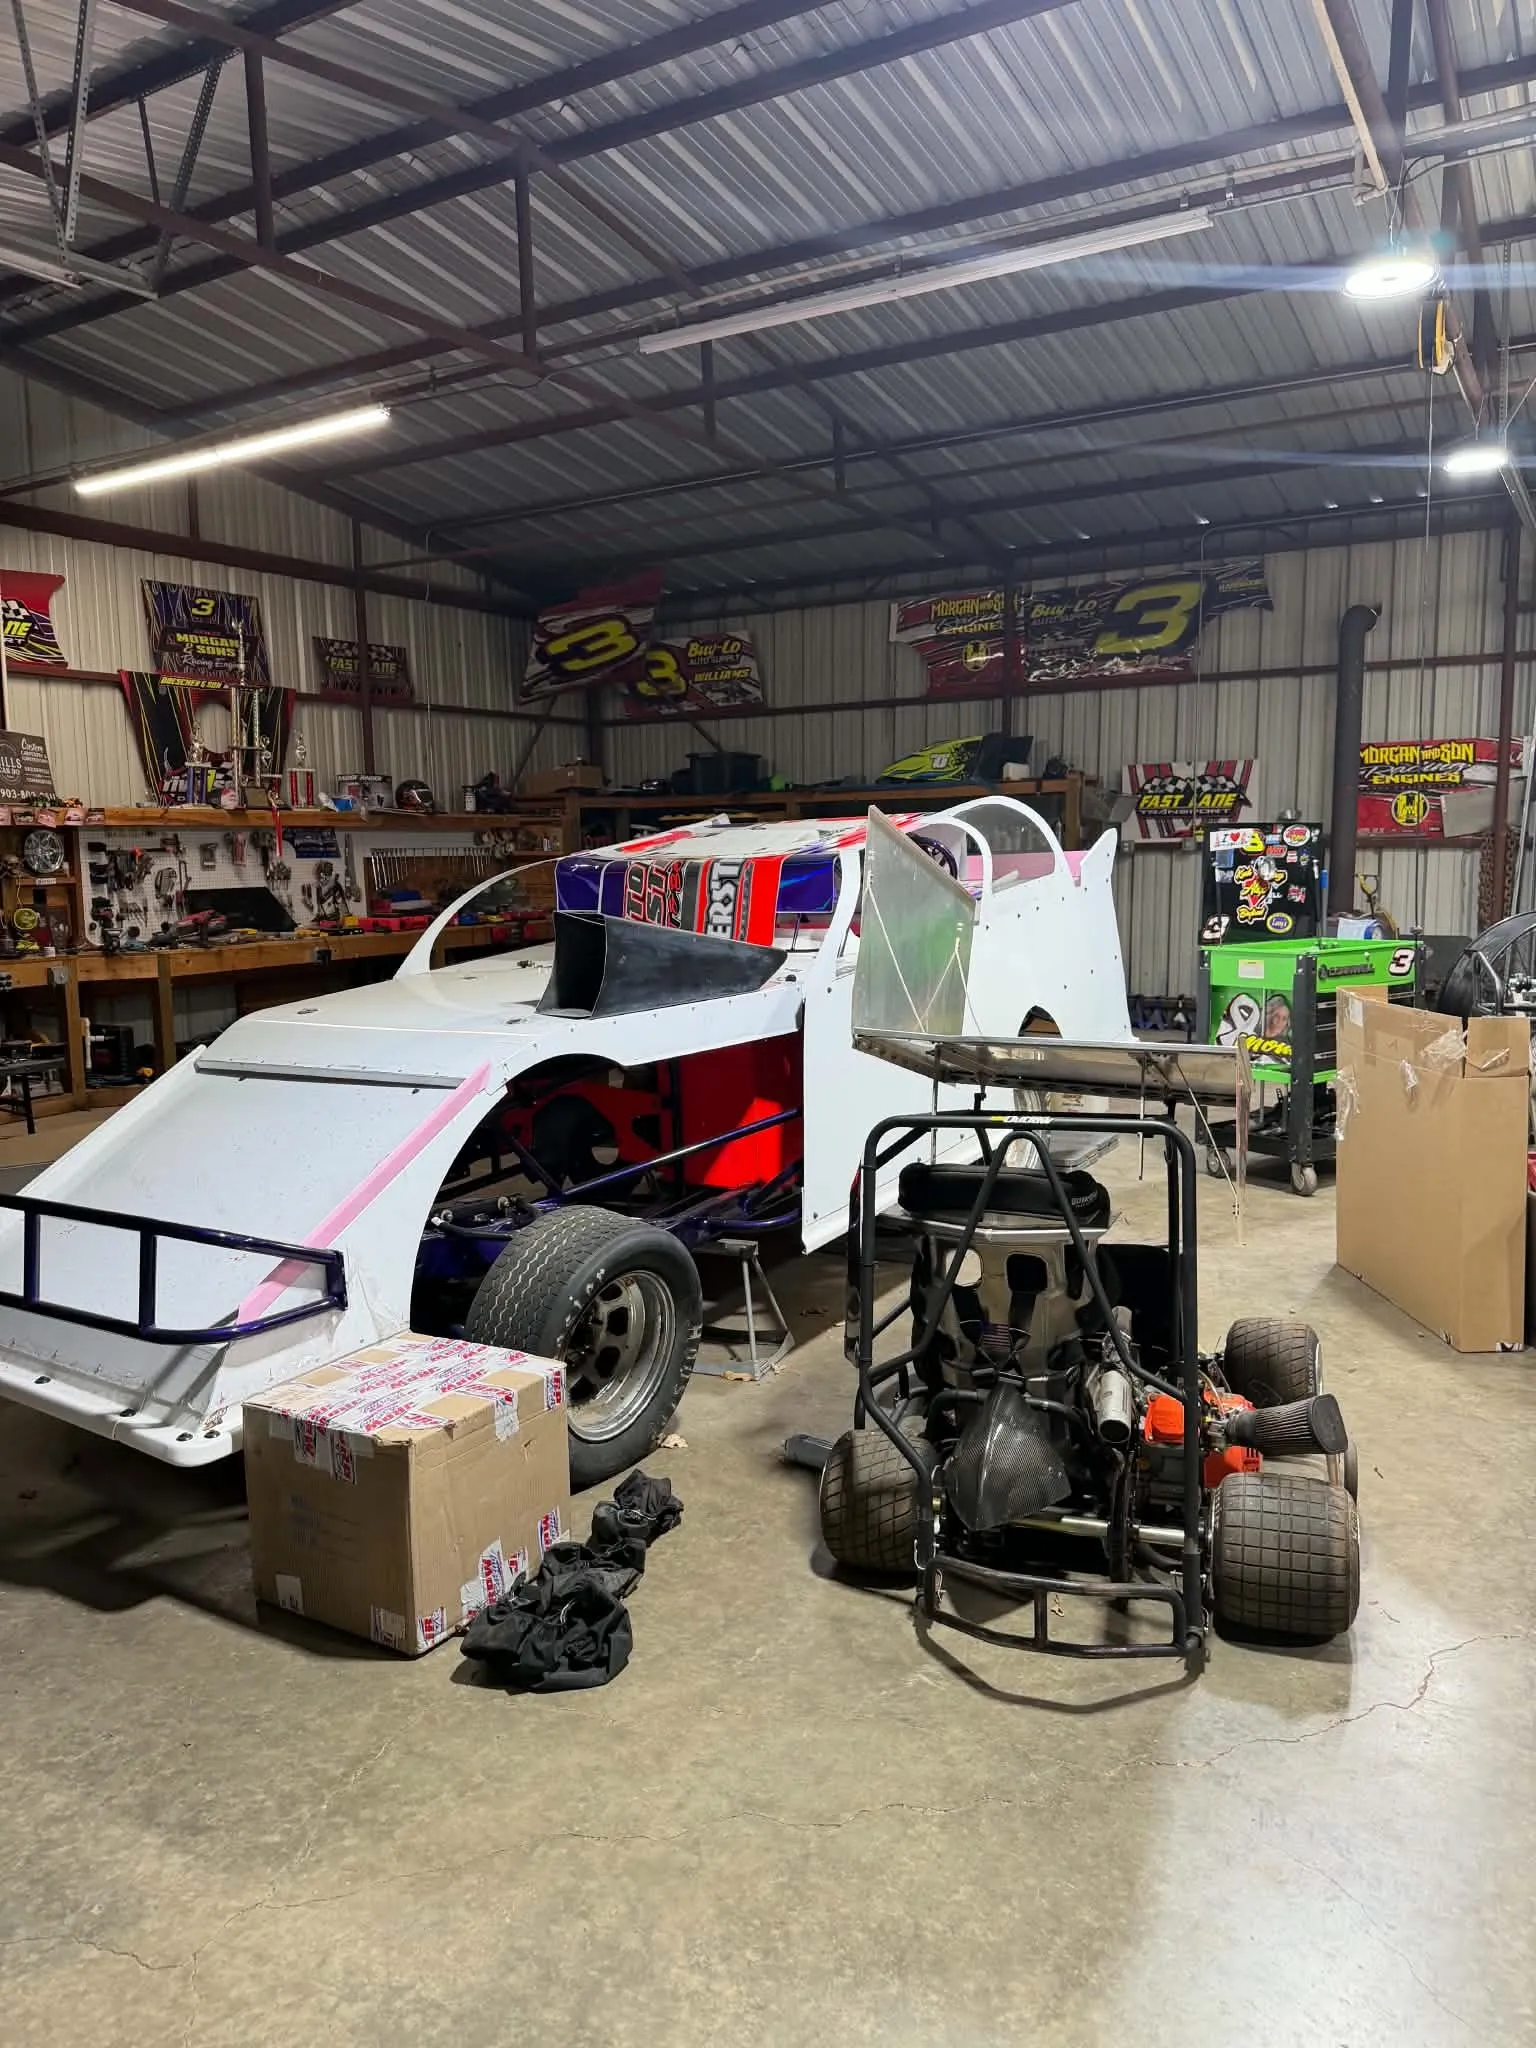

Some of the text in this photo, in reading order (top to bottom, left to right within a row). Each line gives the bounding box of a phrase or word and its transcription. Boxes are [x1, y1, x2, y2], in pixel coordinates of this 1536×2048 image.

[191, 597, 216, 616] 3
[931, 597, 979, 622] MORGAN
[943, 621, 1004, 634] ENGINE
[1097, 582, 1206, 655] 3
[175, 633, 240, 649] MORGAN
[544, 618, 638, 672] 3
[195, 645, 236, 657] SONS
[330, 658, 398, 673] FAST ANE
[636, 651, 689, 696] 3
[694, 668, 749, 682] WILLIAMS
[1360, 745, 1420, 765] MORGAN
[1440, 740, 1475, 765] SON
[1140, 795, 1184, 808] FAST
[1389, 948, 1415, 975] 3
